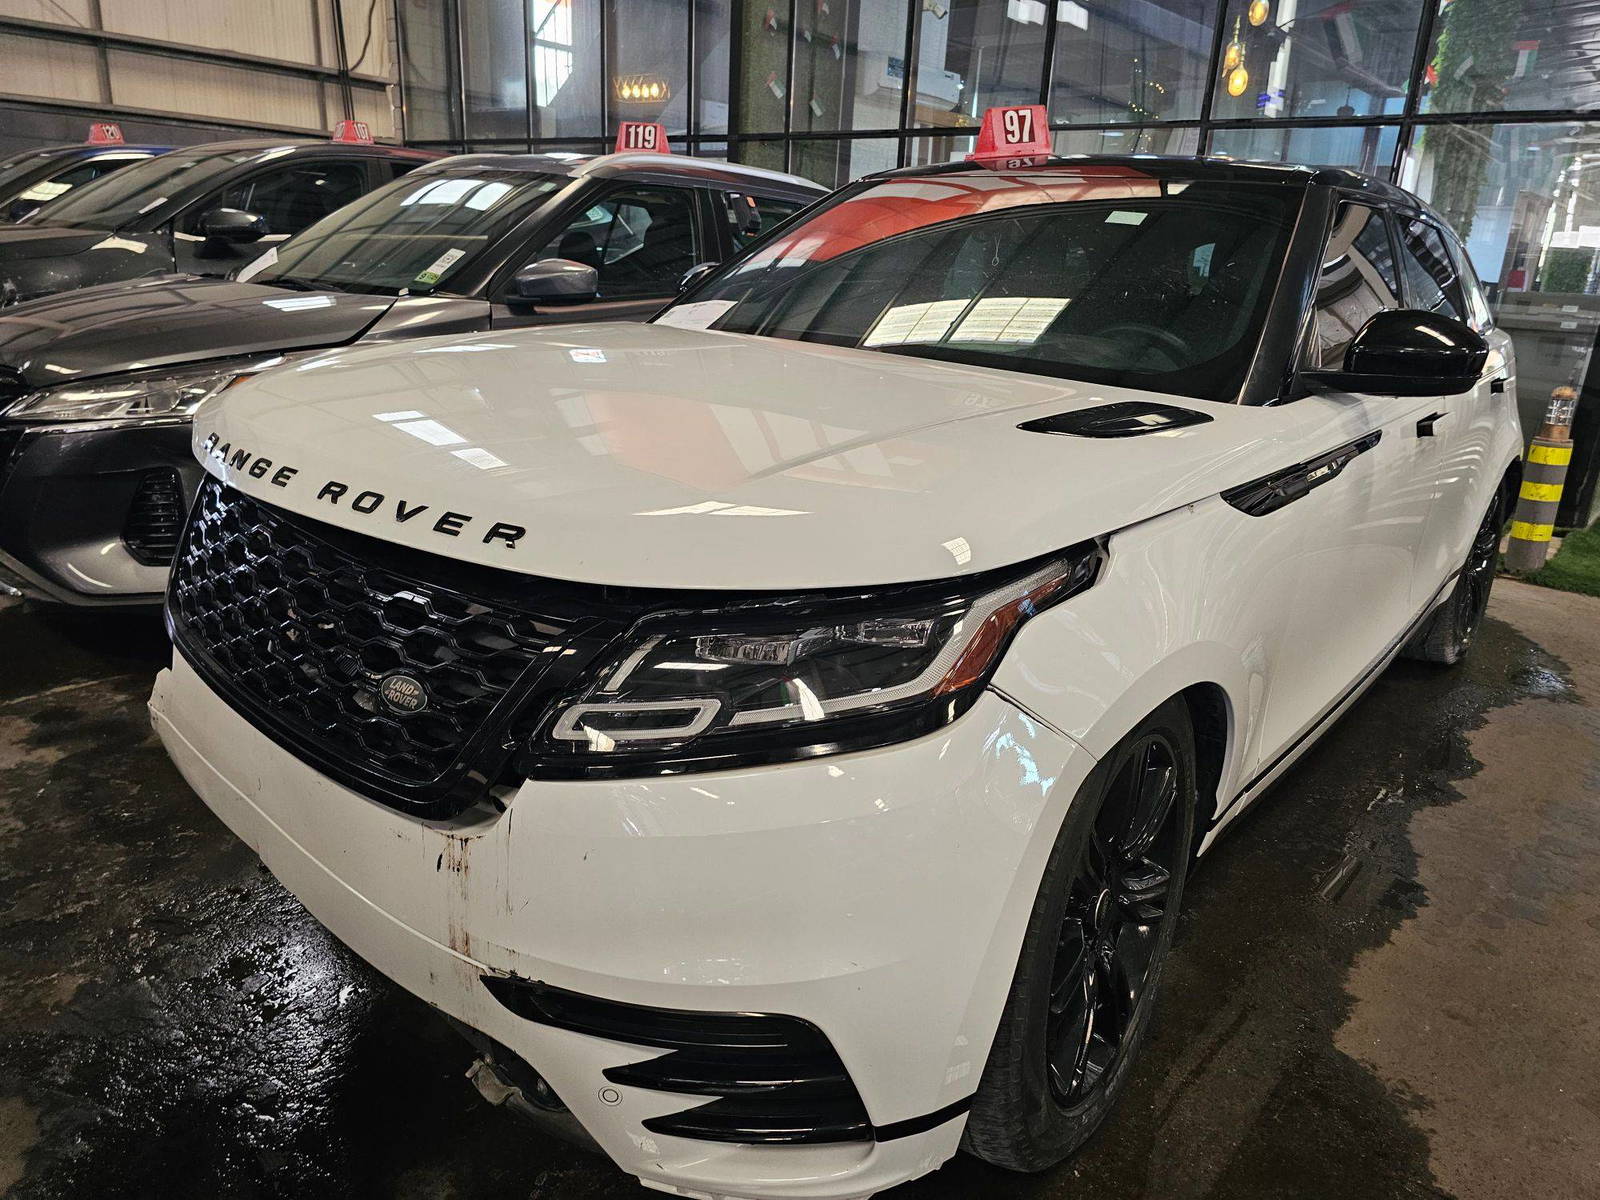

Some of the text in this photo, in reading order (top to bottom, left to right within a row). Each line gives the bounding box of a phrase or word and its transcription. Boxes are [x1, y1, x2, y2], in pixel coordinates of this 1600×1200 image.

[353, 122, 369, 140] 107
[628, 125, 656, 149] 119
[1004, 109, 1032, 143] 97
[201, 432, 527, 549] RANGE ROVER
[389, 678, 415, 695] LAND
[387, 689, 418, 709] ROVER
